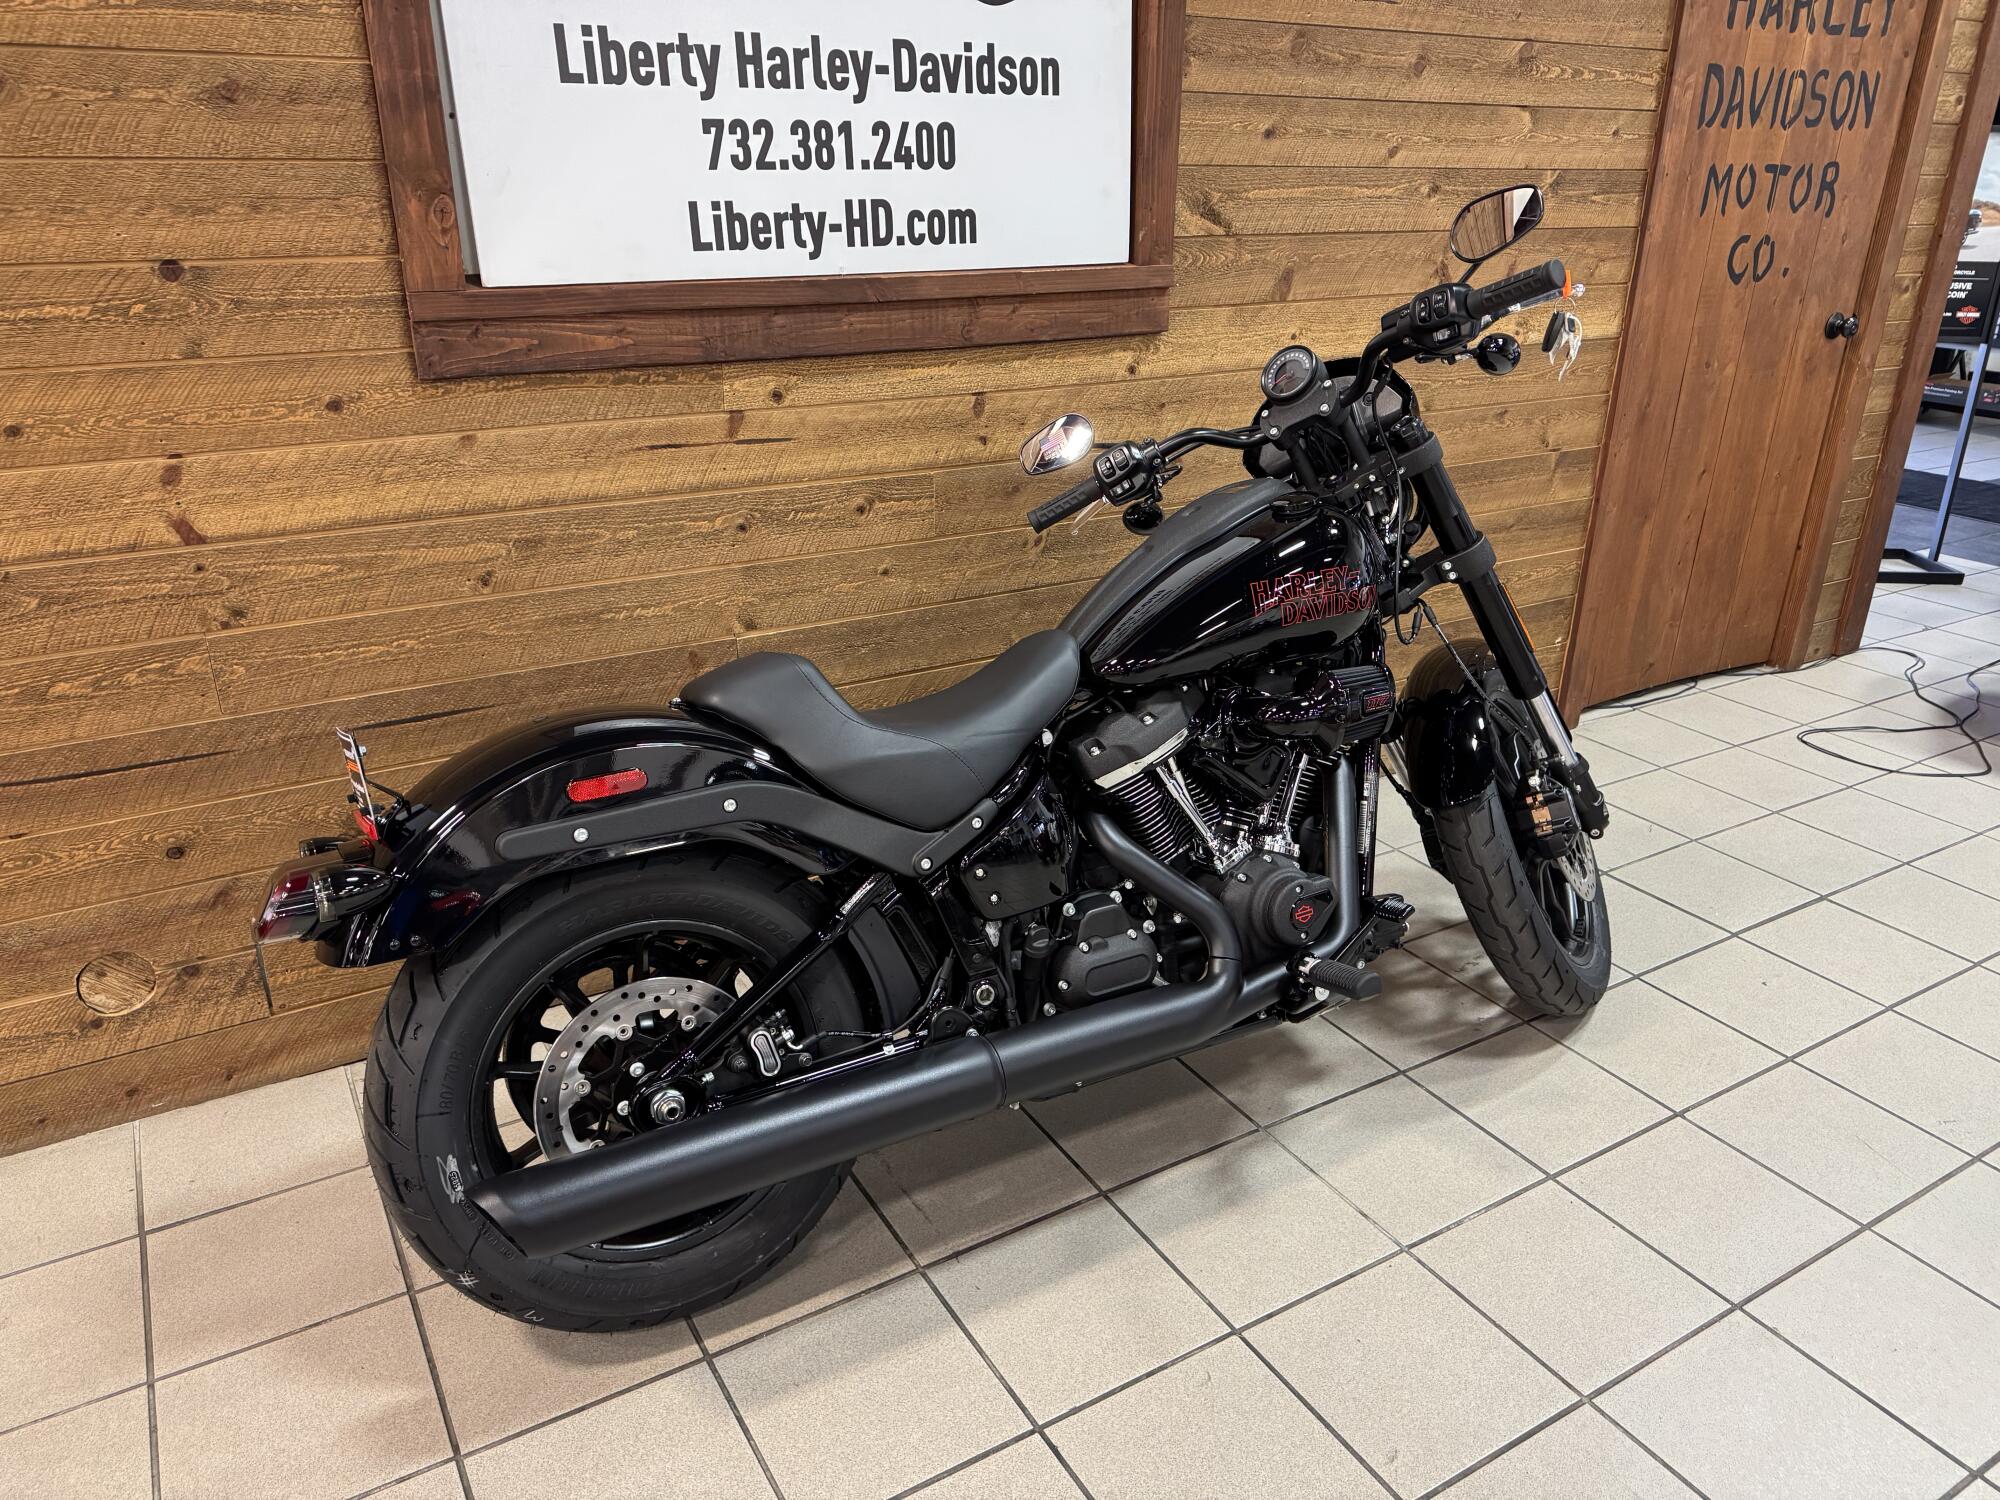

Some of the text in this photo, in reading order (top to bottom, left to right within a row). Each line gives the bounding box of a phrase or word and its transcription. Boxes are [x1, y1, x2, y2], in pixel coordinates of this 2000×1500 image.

[552, 23, 1061, 104] Liberty Harley-Davidson
[1697, 62, 1882, 131] DAVIDSON
[701, 118, 956, 171] 732.381.2400
[1700, 161, 1841, 219] MOTOR
[688, 198, 978, 260] Liberty-HD.com
[1726, 234, 1791, 286] CO.
